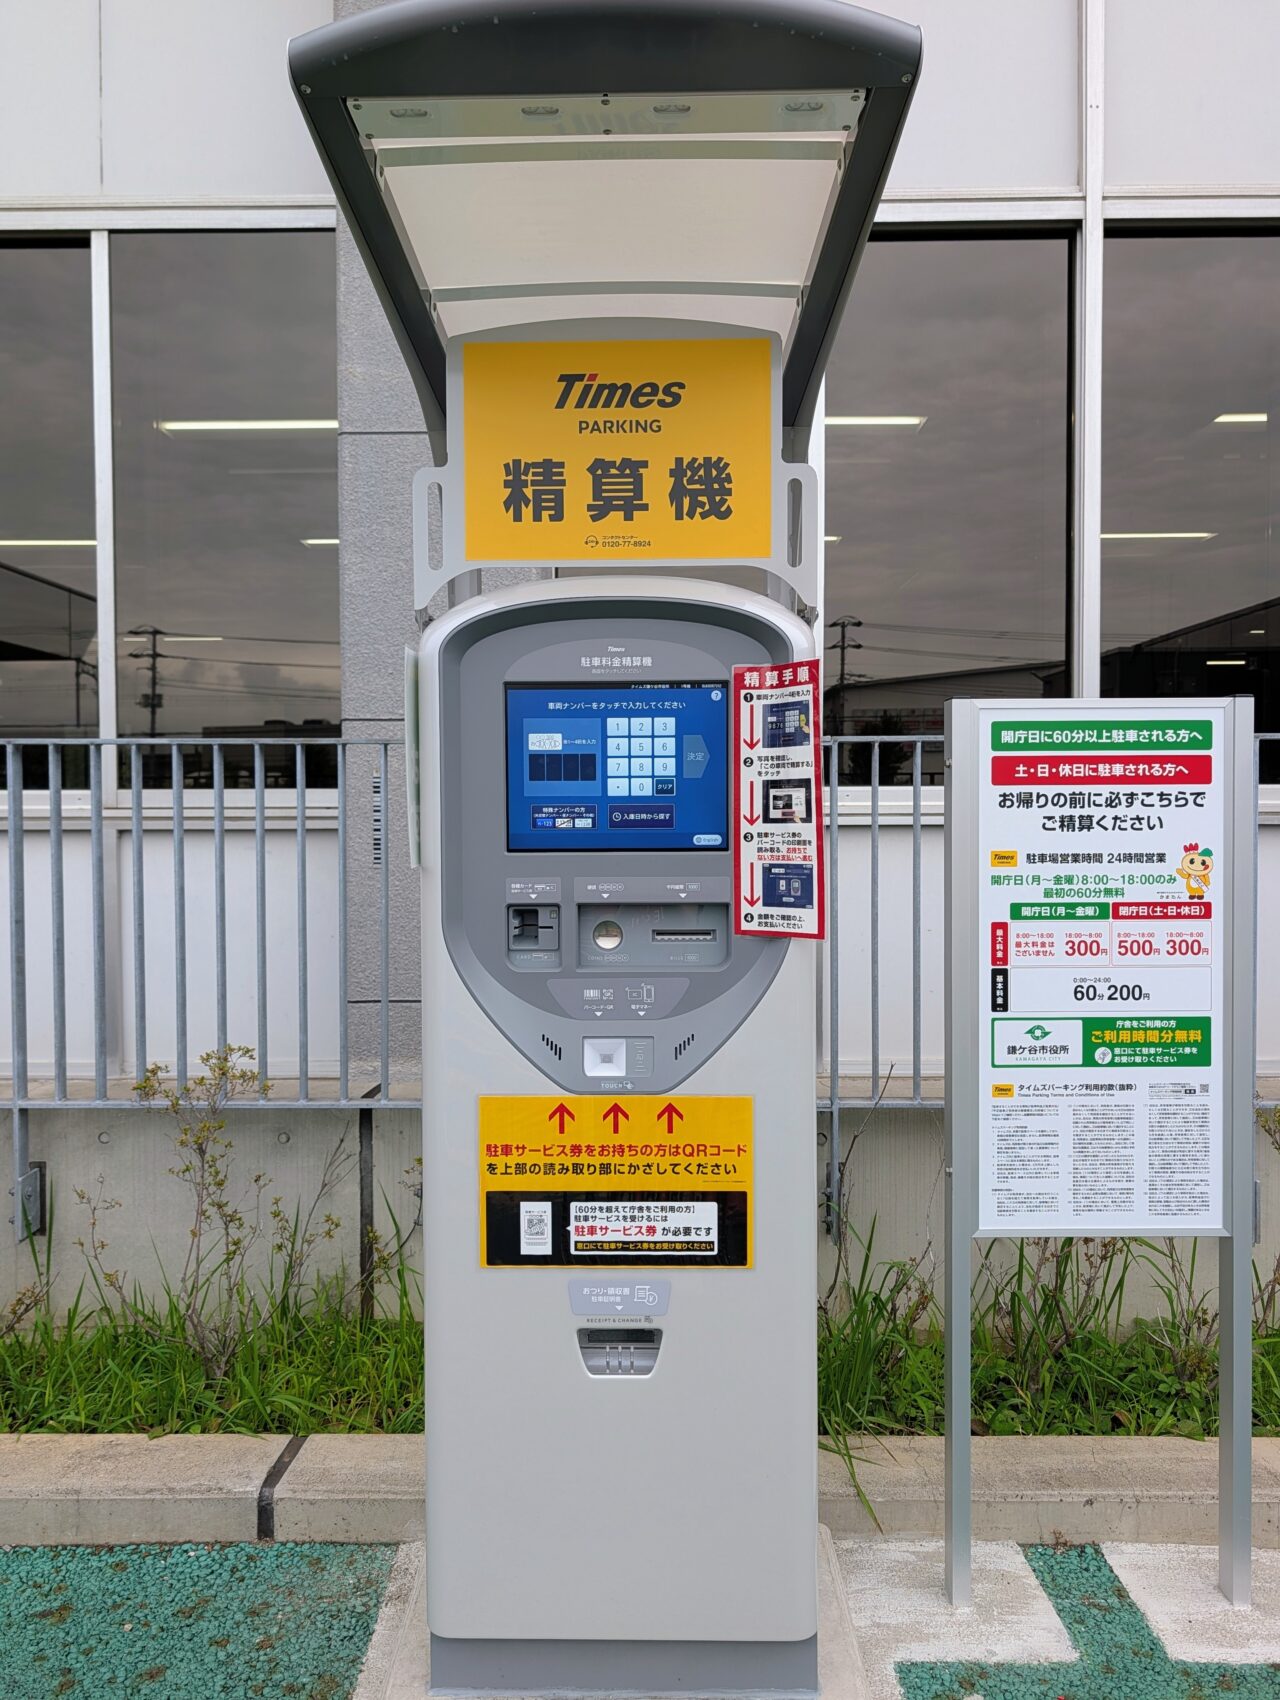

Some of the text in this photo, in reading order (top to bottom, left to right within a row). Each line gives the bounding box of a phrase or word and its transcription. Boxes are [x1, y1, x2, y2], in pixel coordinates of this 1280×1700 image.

[554, 373, 686, 409] Times
[578, 419, 662, 434] PARKING
[503, 457, 733, 522] 精算機
[602, 540, 651, 548] 0120-77-8924
[580, 656, 652, 667] 駐車料金精算機
[744, 666, 809, 687] 精算手順
[548, 701, 686, 710] 車両ナンバーをタッチで入力してください
[1001, 730, 1203, 743] 開庁日に60分以上駐車される方へ
[686, 751, 704, 761] 決定
[1015, 764, 1189, 777] 土・日・休日に駐車される方へ
[998, 791, 1206, 809] お帰りの前に必ずこちらで
[1041, 814, 1164, 832] ご精算ください
[1026, 853, 1166, 864] 駐車場営業時間 24時間営業
[1043, 888, 1125, 899] 最初の60分無料
[1064, 939, 1209, 956] 300円 500円 300円
[1073, 985, 1150, 1001] 60分 200円
[1116, 1020, 1176, 1028] 庁舎をご利用の方
[1091, 1029, 1203, 1043] ご利用時間分無料
[1114, 1047, 1198, 1055] 窓口にて駐車サービス券を
[1114, 1055, 1177, 1063] お受け取りください
[486, 1143, 747, 1158] 駐車サービス券をお持ちの方はQRコード
[486, 1162, 737, 1175] を上部の読み取り部にかざしてください
[574, 1225, 712, 1237] 駐車サービス券 が必要です
